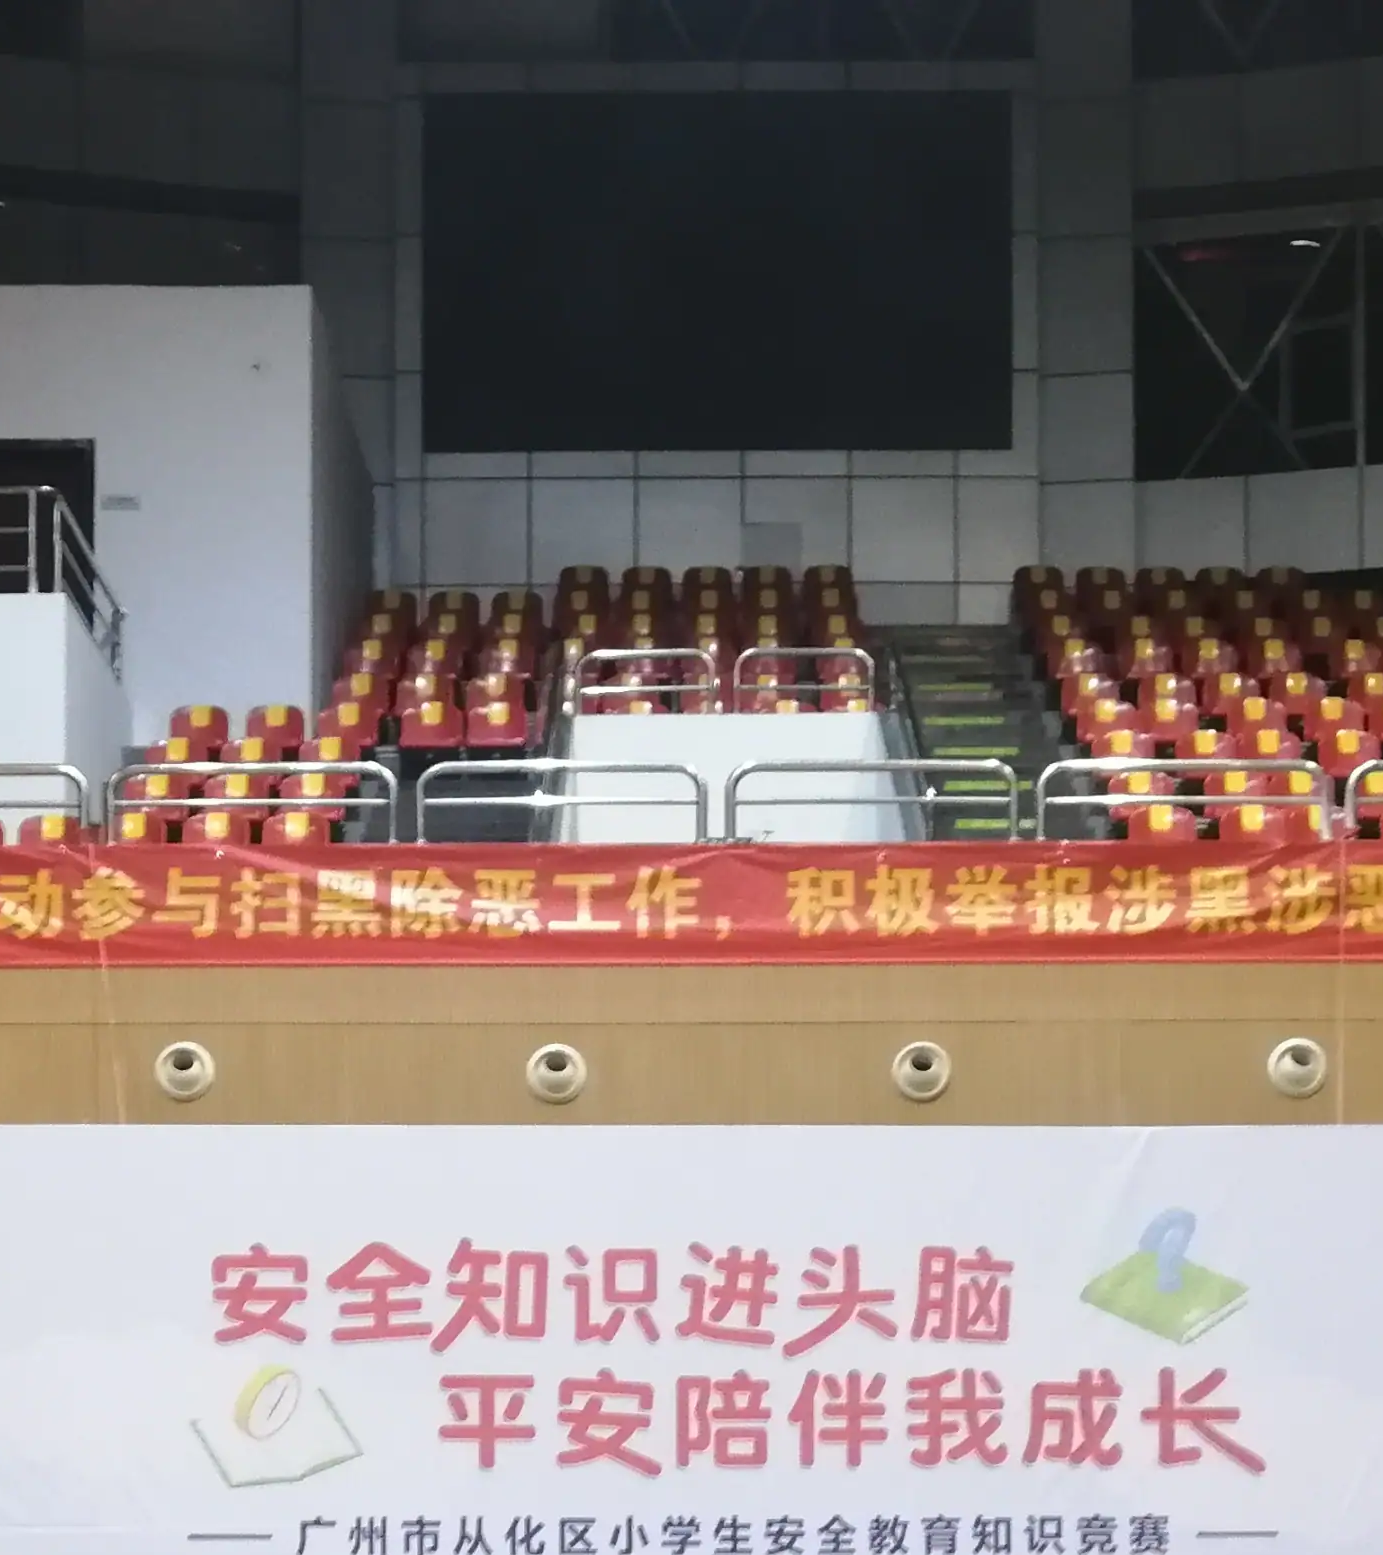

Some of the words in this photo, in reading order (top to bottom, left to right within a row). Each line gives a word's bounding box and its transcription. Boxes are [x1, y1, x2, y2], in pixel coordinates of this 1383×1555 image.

[212, 1237, 1014, 1358] 安全知识进头脑
[438, 1366, 1268, 1479] 平安陪伴我成长
